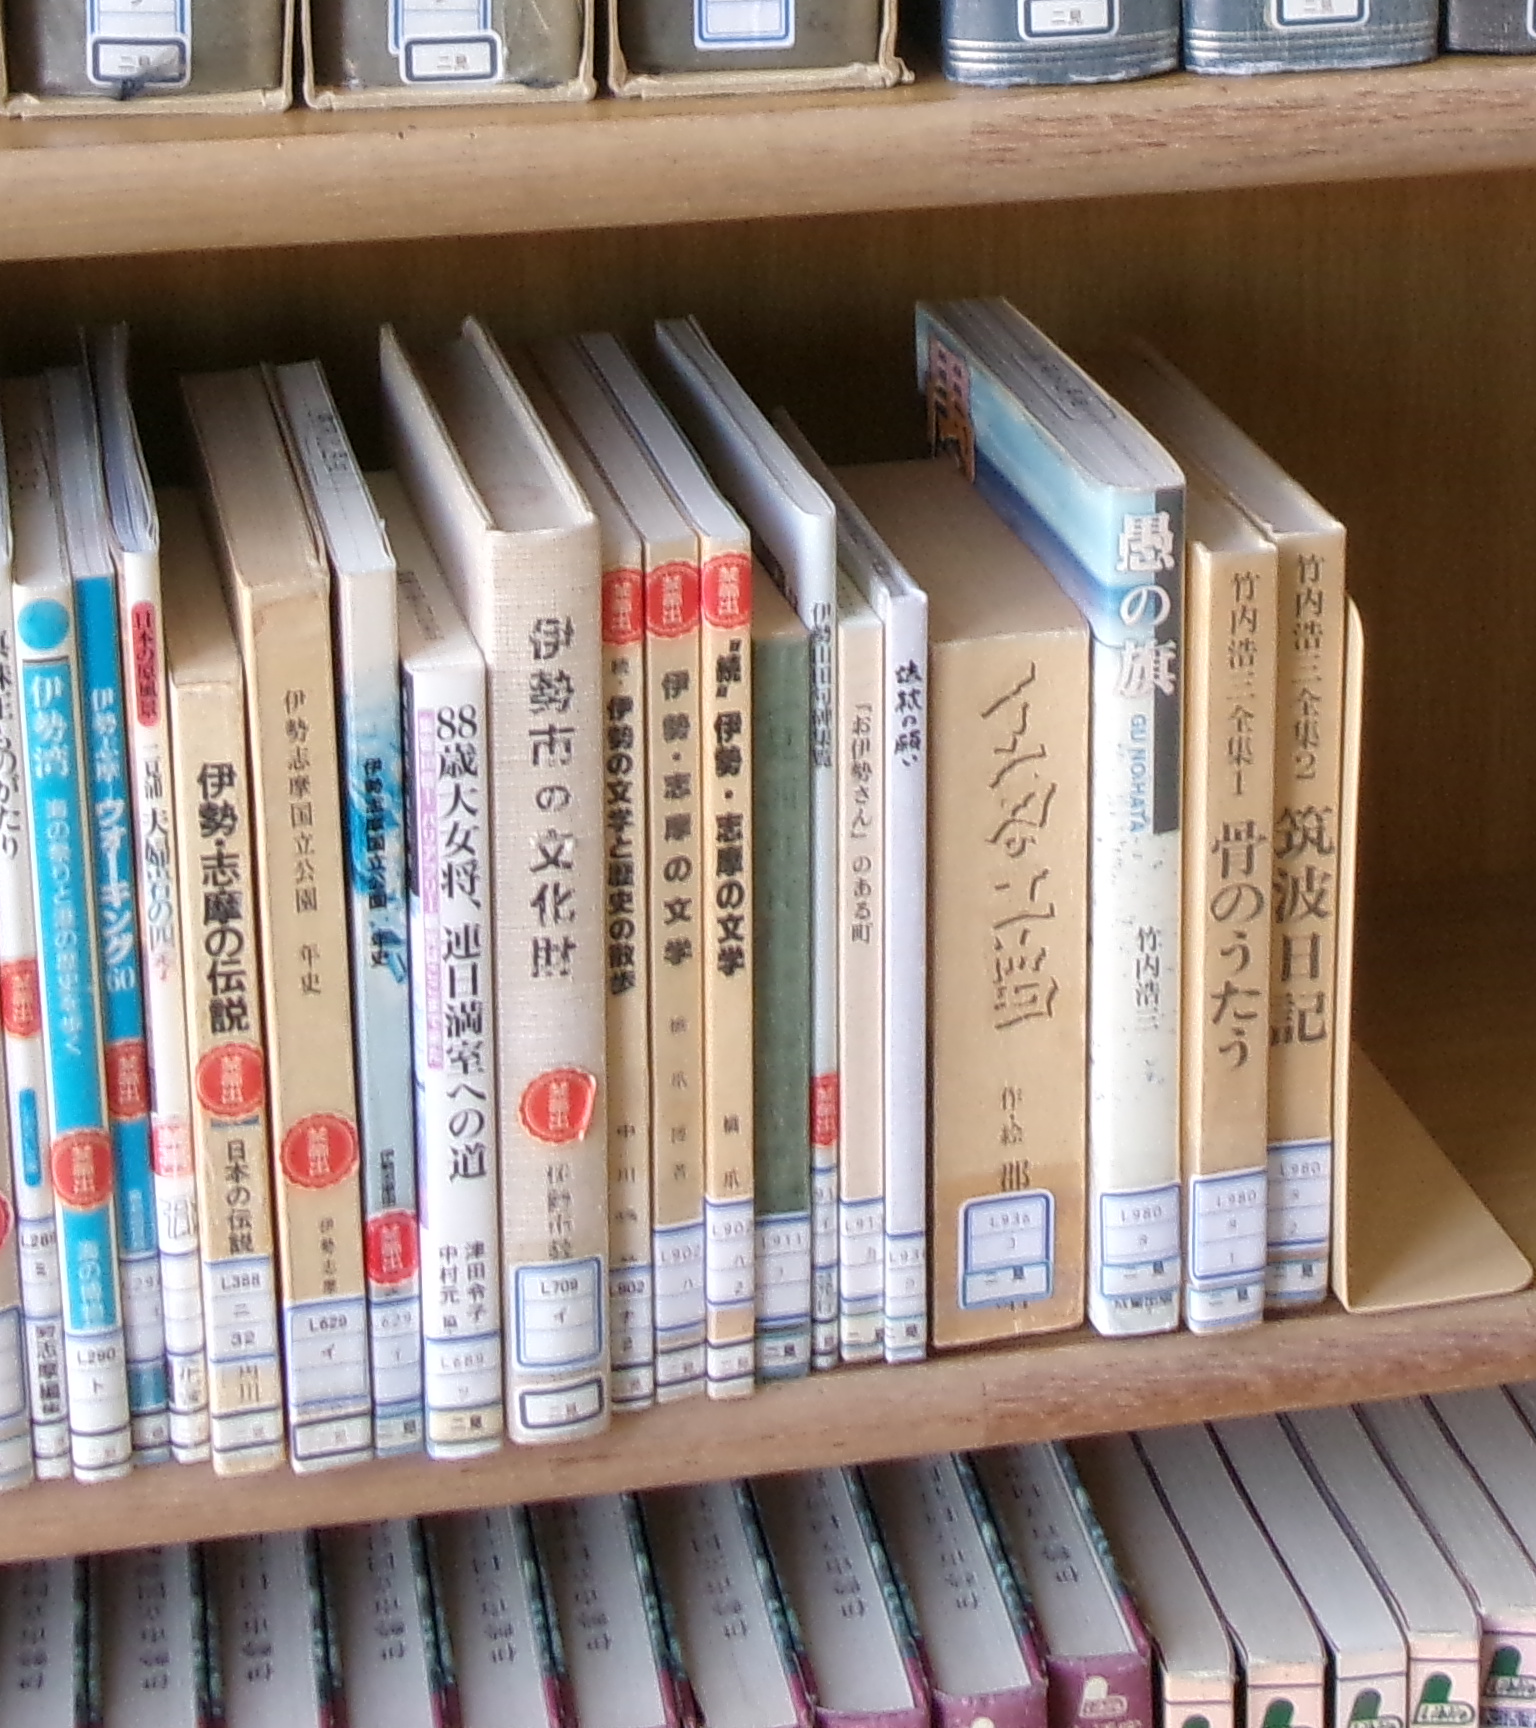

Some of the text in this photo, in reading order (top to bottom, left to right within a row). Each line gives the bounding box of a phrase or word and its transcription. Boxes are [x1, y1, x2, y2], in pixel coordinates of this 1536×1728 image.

[195, 760, 250, 1036] 伊勢・志摩の伝説
[282, 688, 320, 916] 伊勢志摩国立公園
[526, 616, 578, 980] 伊勢市の文化財
[1132, 922, 1164, 1032] 竹内浩三
[1208, 818, 1268, 1071] 骨のうたう
[1270, 805, 1336, 1048] 筑波日記
[225, 1138, 256, 1256] 日本の伝説
